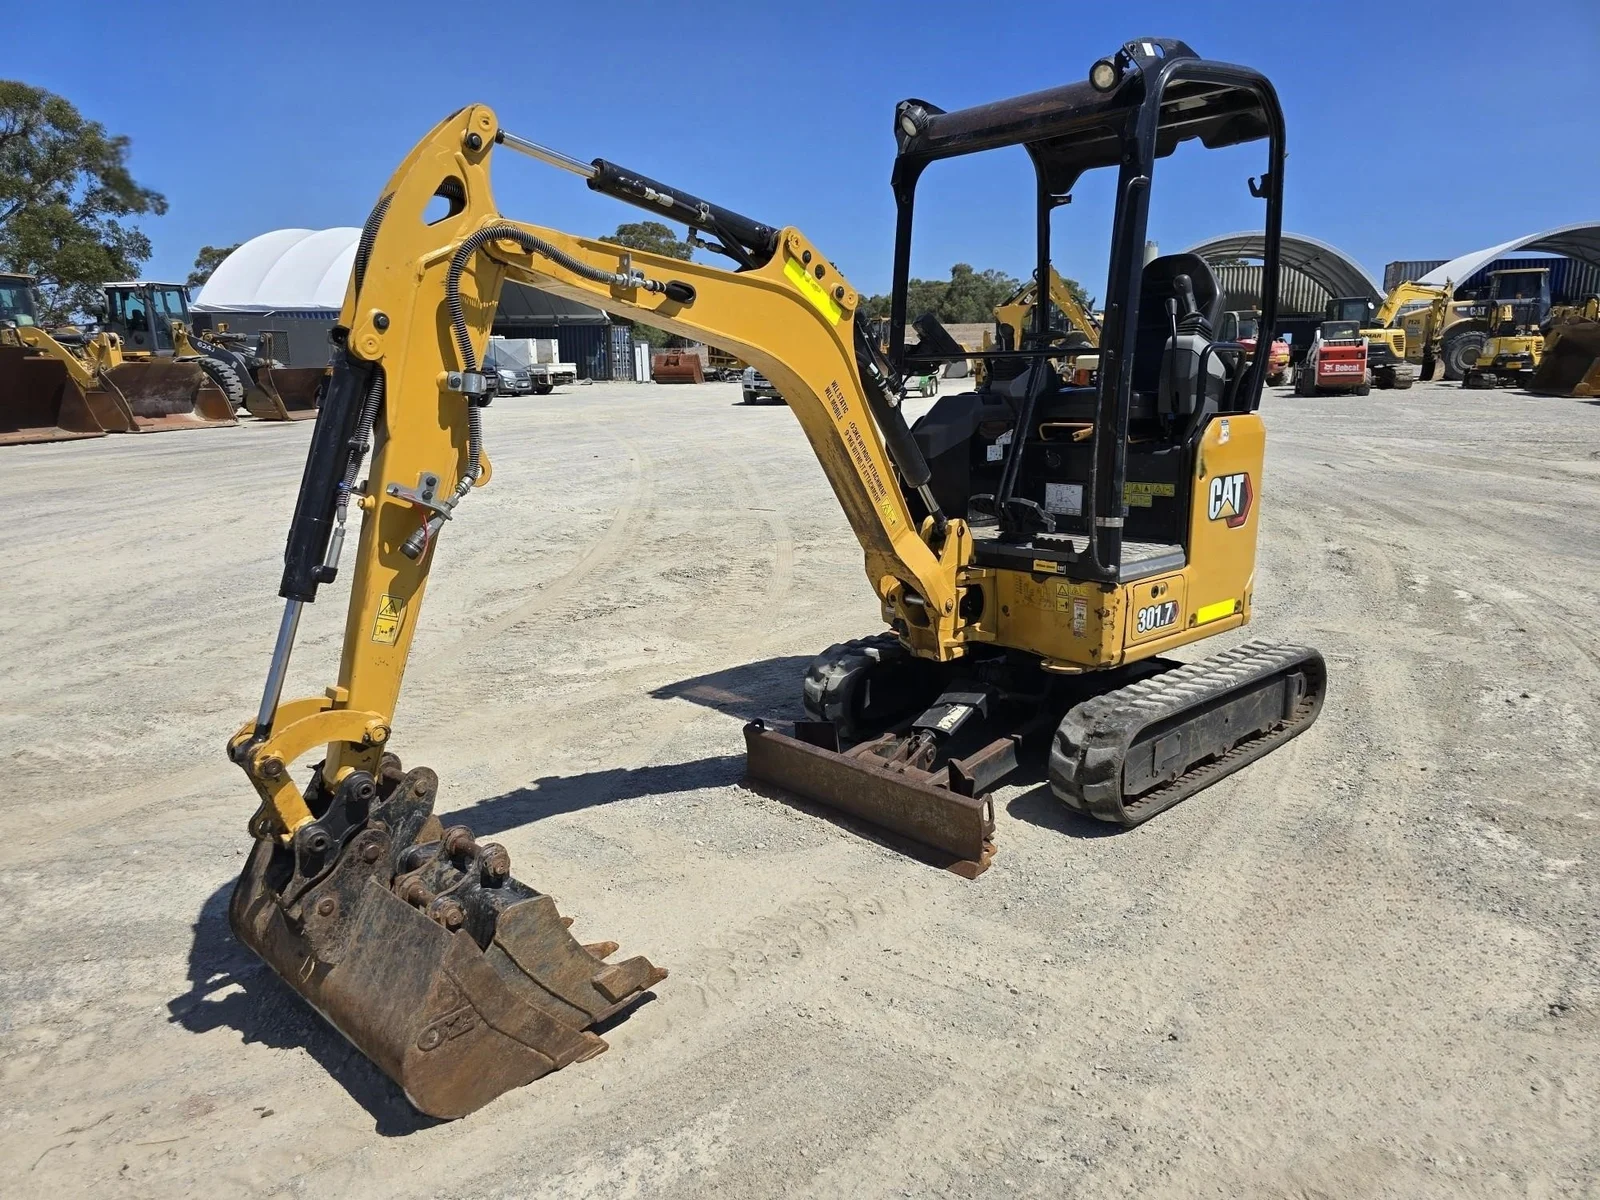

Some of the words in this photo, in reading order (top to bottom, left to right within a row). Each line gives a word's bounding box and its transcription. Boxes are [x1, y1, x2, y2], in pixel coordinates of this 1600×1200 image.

[1470, 306, 1487, 316] CAT
[197, 341, 215, 352] 624J
[1335, 364, 1360, 372] Bobcat
[825, 386, 834, 401] WLL
[830, 399, 843, 421] MOBILE
[862, 469, 881, 503] ATTACHMENT
[831, 379, 840, 394] WLL
[837, 392, 849, 414] STATIC
[857, 439, 872, 464] WITHOUT
[868, 463, 887, 497] ATTACHMENT
[1209, 474, 1245, 520] CAT
[1137, 602, 1173, 632] 301.7
